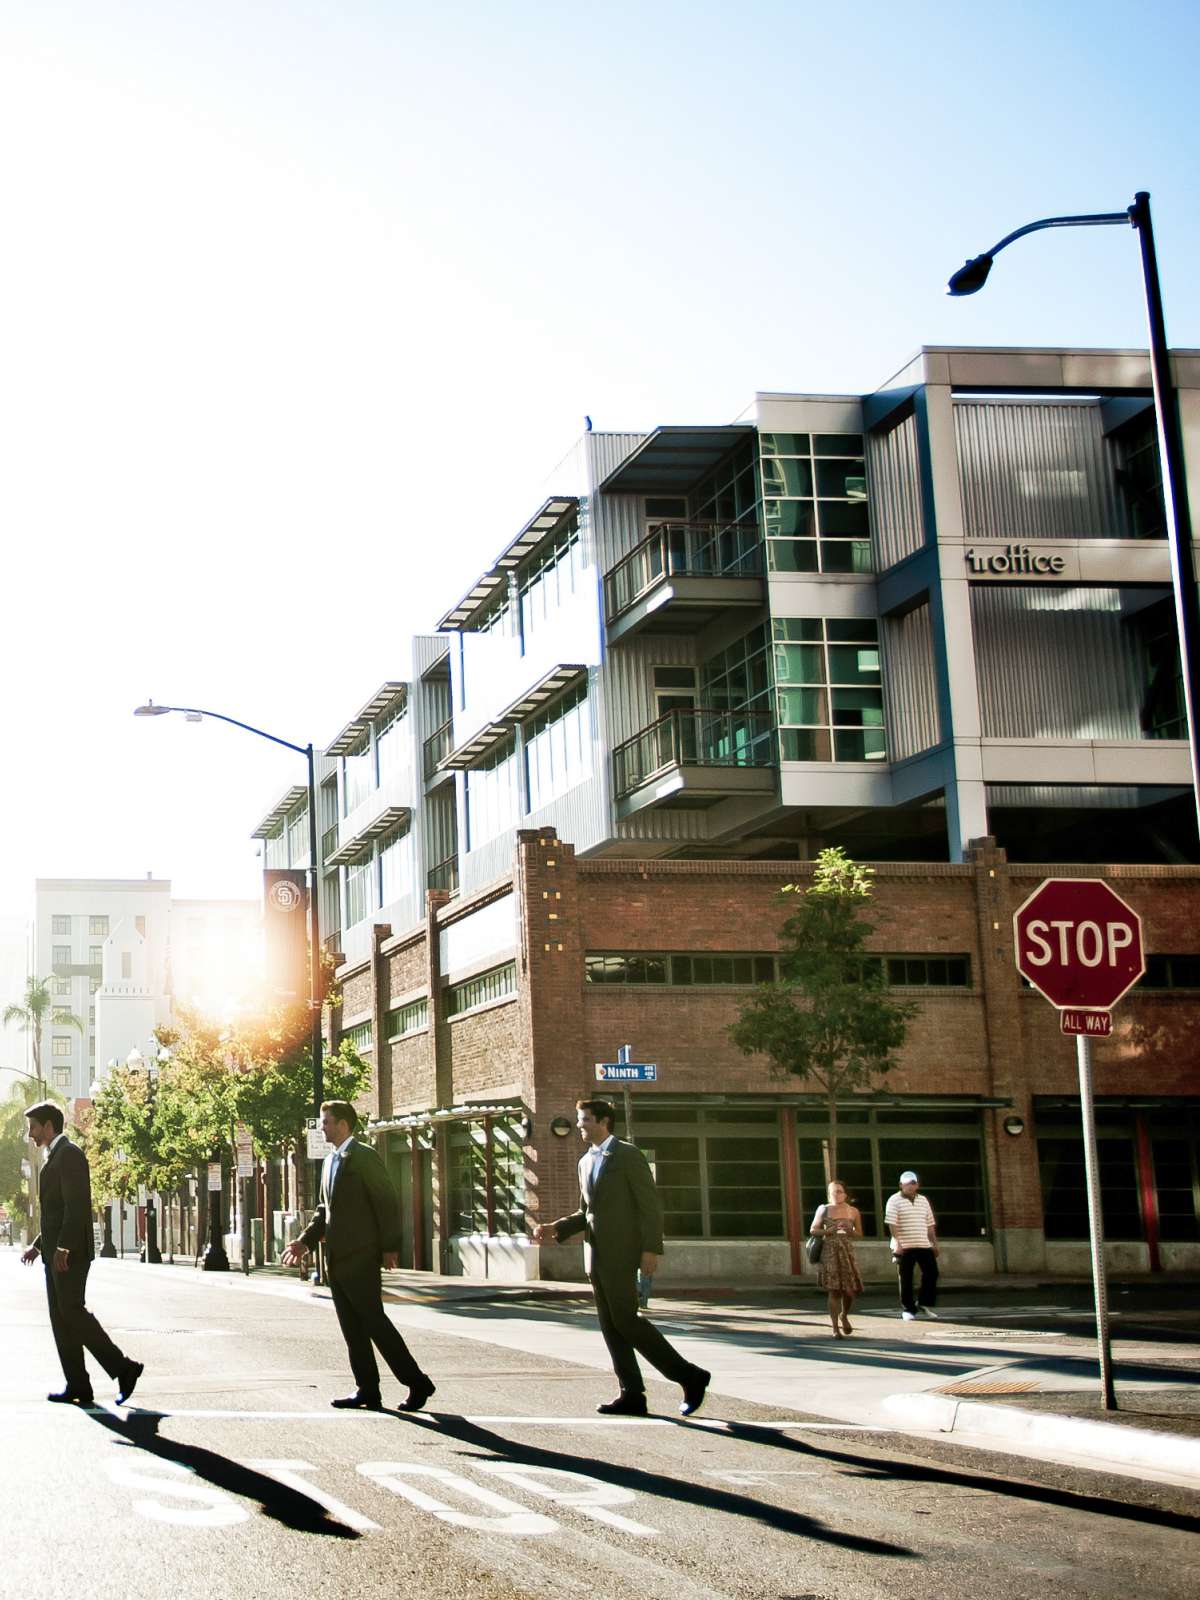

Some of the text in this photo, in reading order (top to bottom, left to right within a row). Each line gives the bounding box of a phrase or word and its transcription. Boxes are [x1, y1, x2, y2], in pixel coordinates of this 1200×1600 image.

[1026, 919, 1133, 968] STOP
[1063, 1014, 1108, 1031] ALL WAY
[607, 1066, 639, 1078] NINTH
[102, 1456, 662, 1534] STOP
